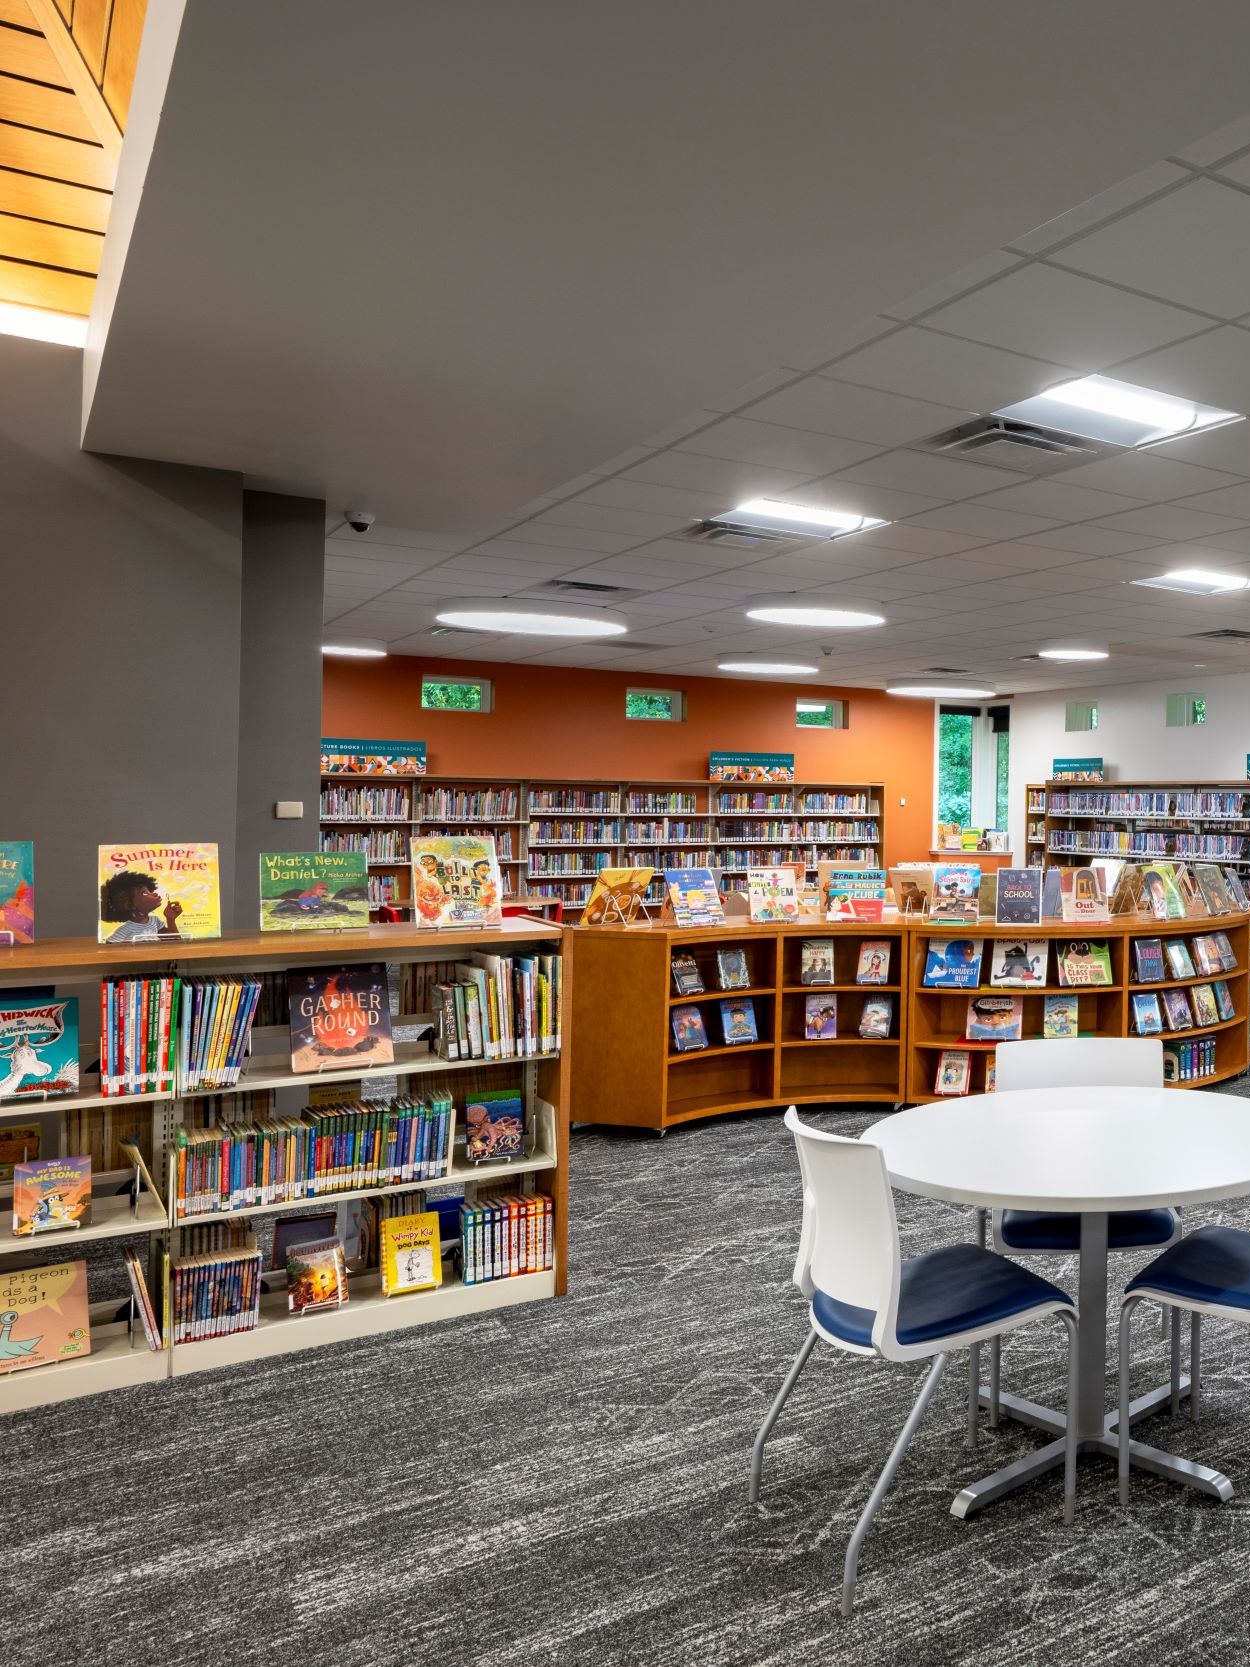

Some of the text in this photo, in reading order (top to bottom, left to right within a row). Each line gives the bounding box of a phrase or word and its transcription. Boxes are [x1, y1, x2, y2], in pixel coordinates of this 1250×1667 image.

[110, 848, 194, 868] Summer
[265, 855, 310, 867] What's
[148, 859, 207, 871] Is Here
[436, 861, 478, 877] BUILT
[833, 872, 882, 880] Erno Rubik
[442, 884, 481, 897] LAST
[762, 886, 794, 897] POEM
[854, 890, 880, 899] CUBE
[1003, 890, 1035, 899] SCHOOL
[1075, 901, 1095, 909] Out
[809, 949, 826, 957] HAPPY
[671, 959, 697, 968] Olivetti
[948, 967, 977, 976] PROUDEST
[1067, 969, 1088, 977] CLASS
[954, 974, 969, 983] BLUE
[1070, 975, 1089, 983] PET?
[300, 992, 382, 1017] GATHER
[310, 1010, 380, 1036] ROUND
[25, 1170, 82, 1185] AWESOME
[398, 1217, 426, 1227] DIARY
[391, 1227, 434, 1242] Wimpy Kid
[397, 1239, 430, 1250] DOG DAYS
[8, 1267, 69, 1286] Pigeon
[28, 1284, 38, 1293] a
